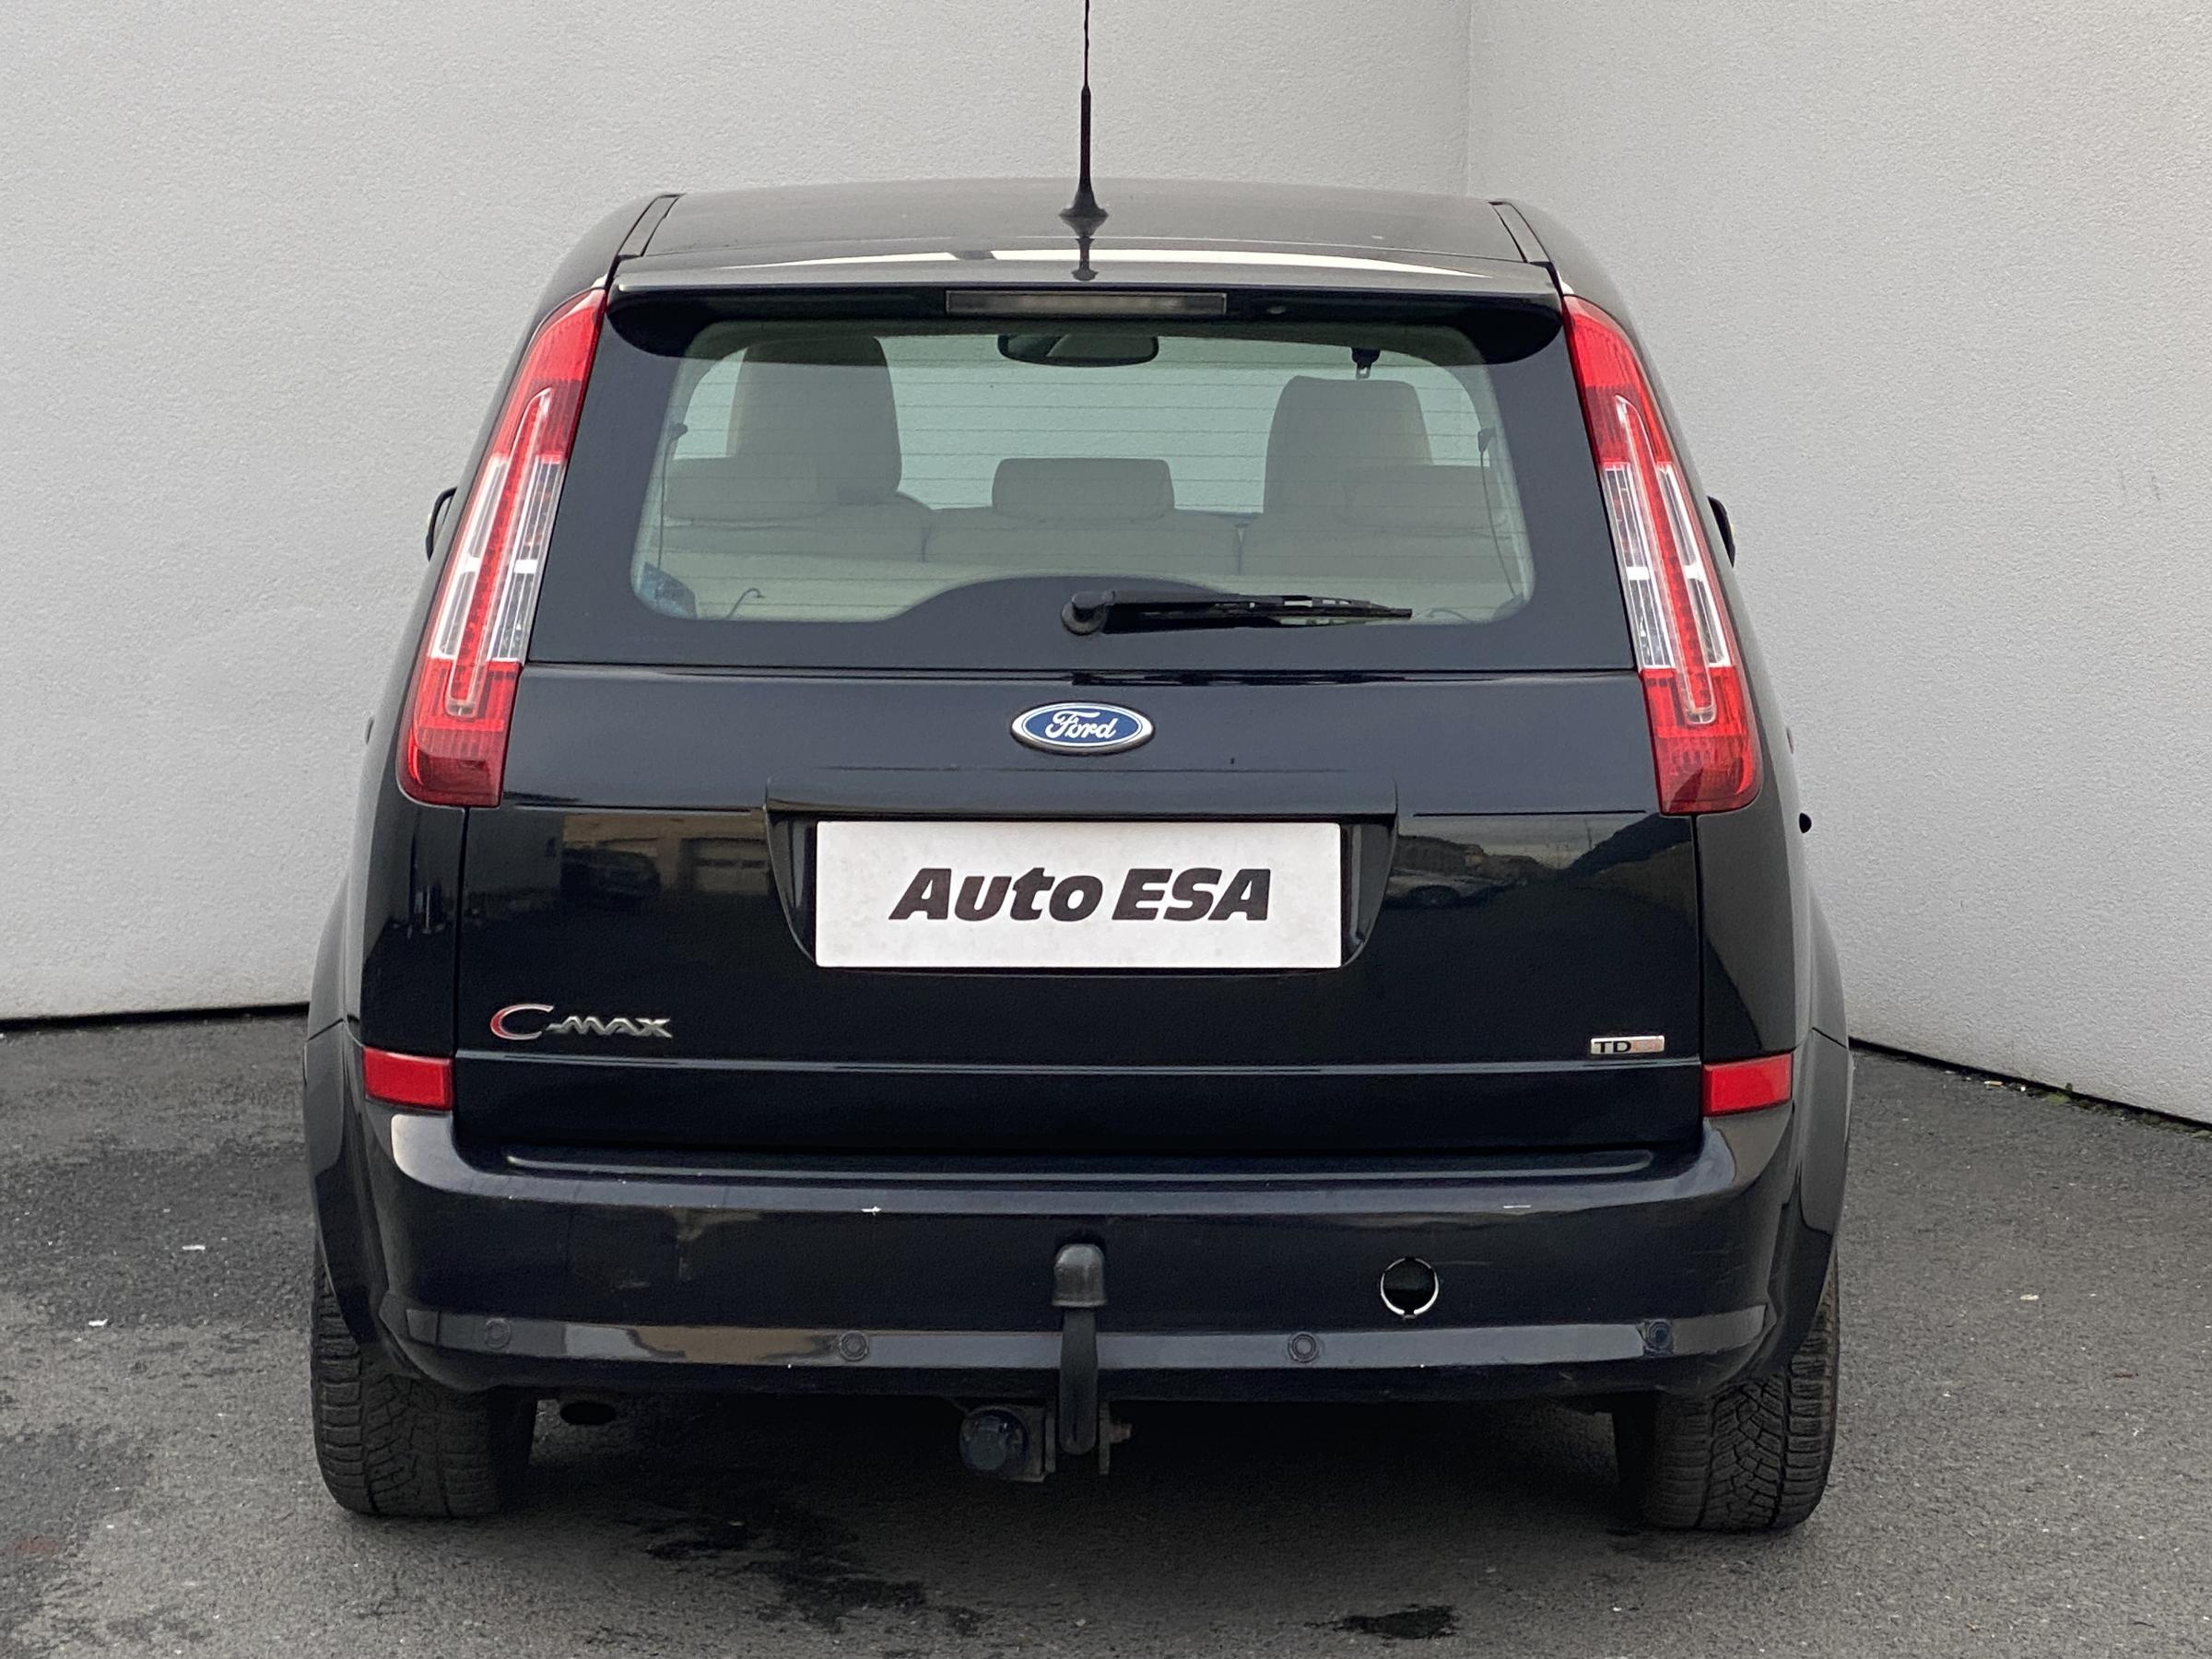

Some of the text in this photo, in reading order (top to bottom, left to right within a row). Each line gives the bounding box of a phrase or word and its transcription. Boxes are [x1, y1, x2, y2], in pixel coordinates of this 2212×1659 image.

[1044, 710, 1119, 739] Ford
[888, 867, 1271, 922] Auto ESA
